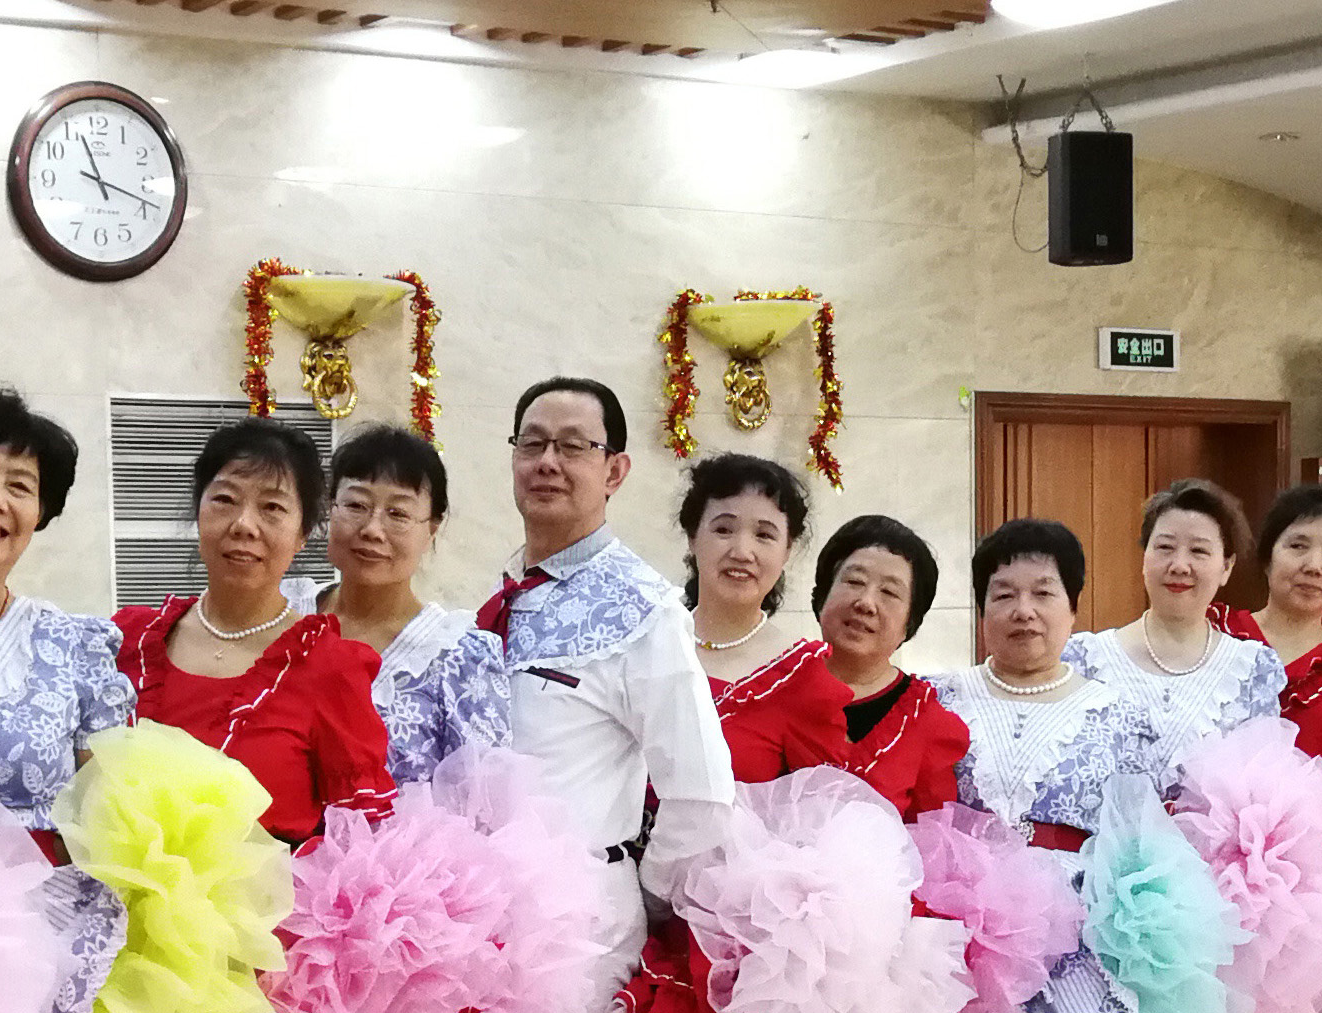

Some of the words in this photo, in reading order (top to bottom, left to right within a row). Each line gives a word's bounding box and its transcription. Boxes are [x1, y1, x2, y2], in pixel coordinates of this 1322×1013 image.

[89, 116, 108, 136] 12
[120, 125, 126, 145] 1
[46, 141, 65, 160] 10
[136, 147, 148, 166] 2
[41, 168, 56, 188] 9
[70, 221, 83, 241] 7
[93, 227, 108, 247] 6
[117, 223, 132, 242] 5
[1117, 337, 1164, 356] 安全出口
[1130, 355, 1153, 363] EXIT
